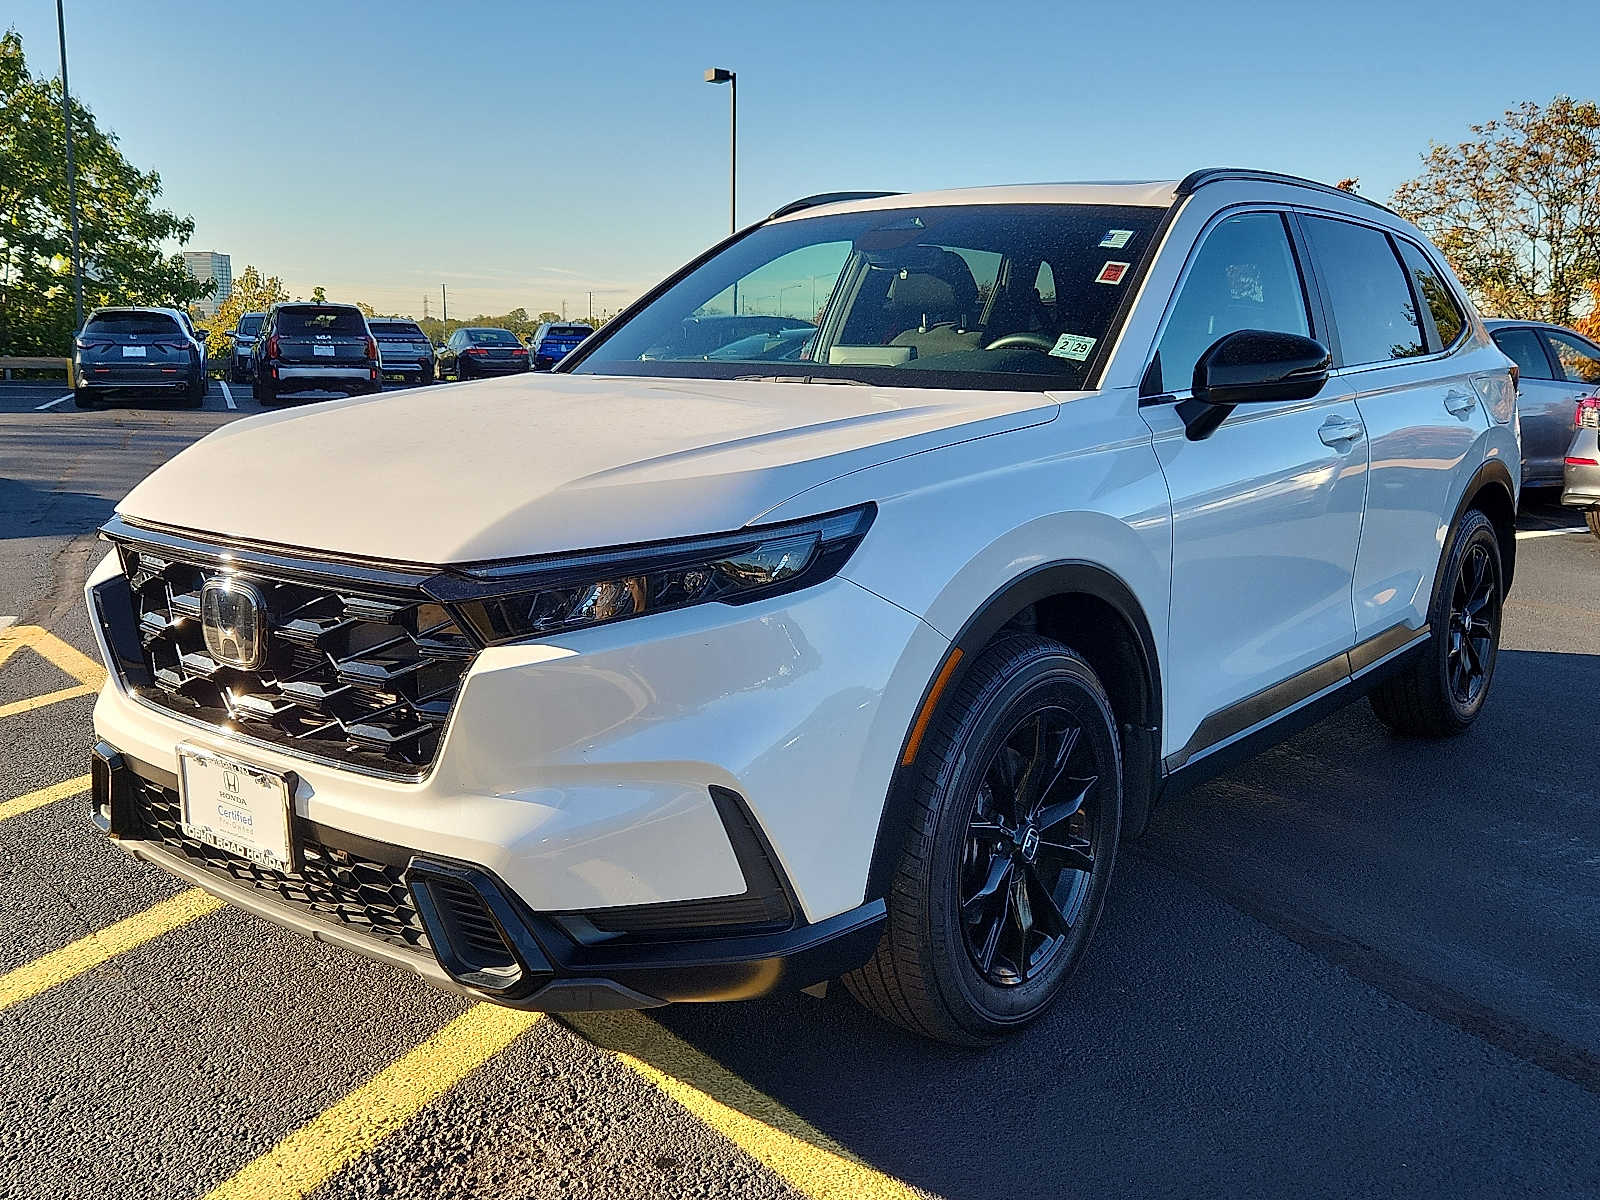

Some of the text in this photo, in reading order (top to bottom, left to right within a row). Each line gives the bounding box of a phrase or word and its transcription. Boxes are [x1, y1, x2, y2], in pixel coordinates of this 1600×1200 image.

[1059, 341, 1069, 350] 2
[1072, 343, 1088, 353] 29
[219, 791, 247, 806] HONDA
[217, 805, 253, 826] Certified
[248, 848, 283, 869] HONDA
